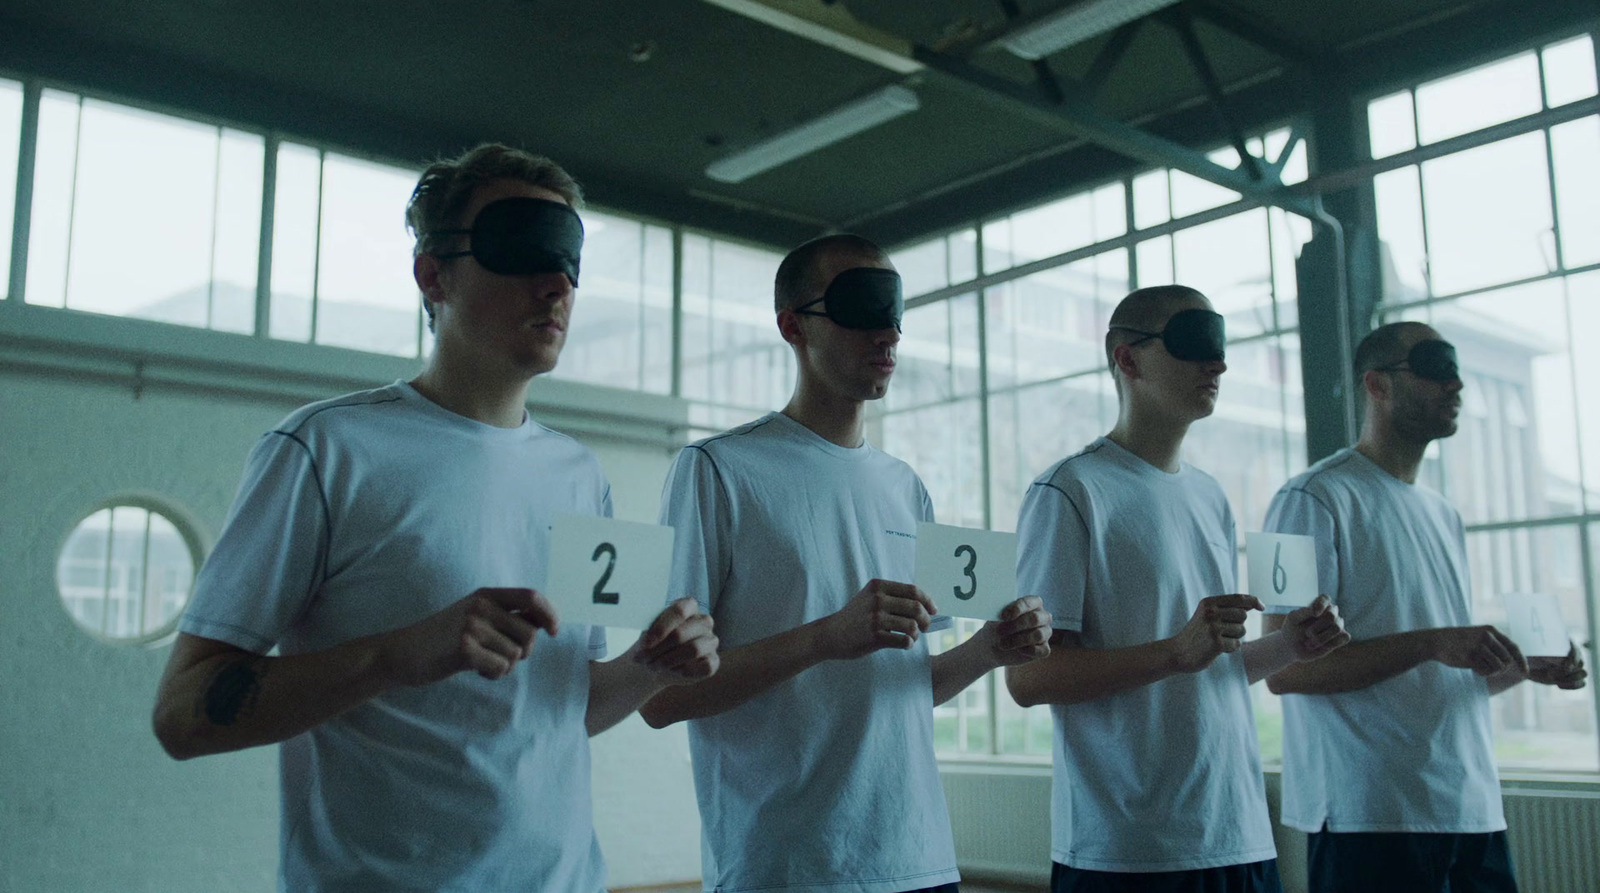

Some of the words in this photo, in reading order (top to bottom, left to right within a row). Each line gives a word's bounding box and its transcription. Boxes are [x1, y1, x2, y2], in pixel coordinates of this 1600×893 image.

[591, 542, 619, 605] 2
[953, 544, 977, 601] 3
[1272, 541, 1287, 595] 6
